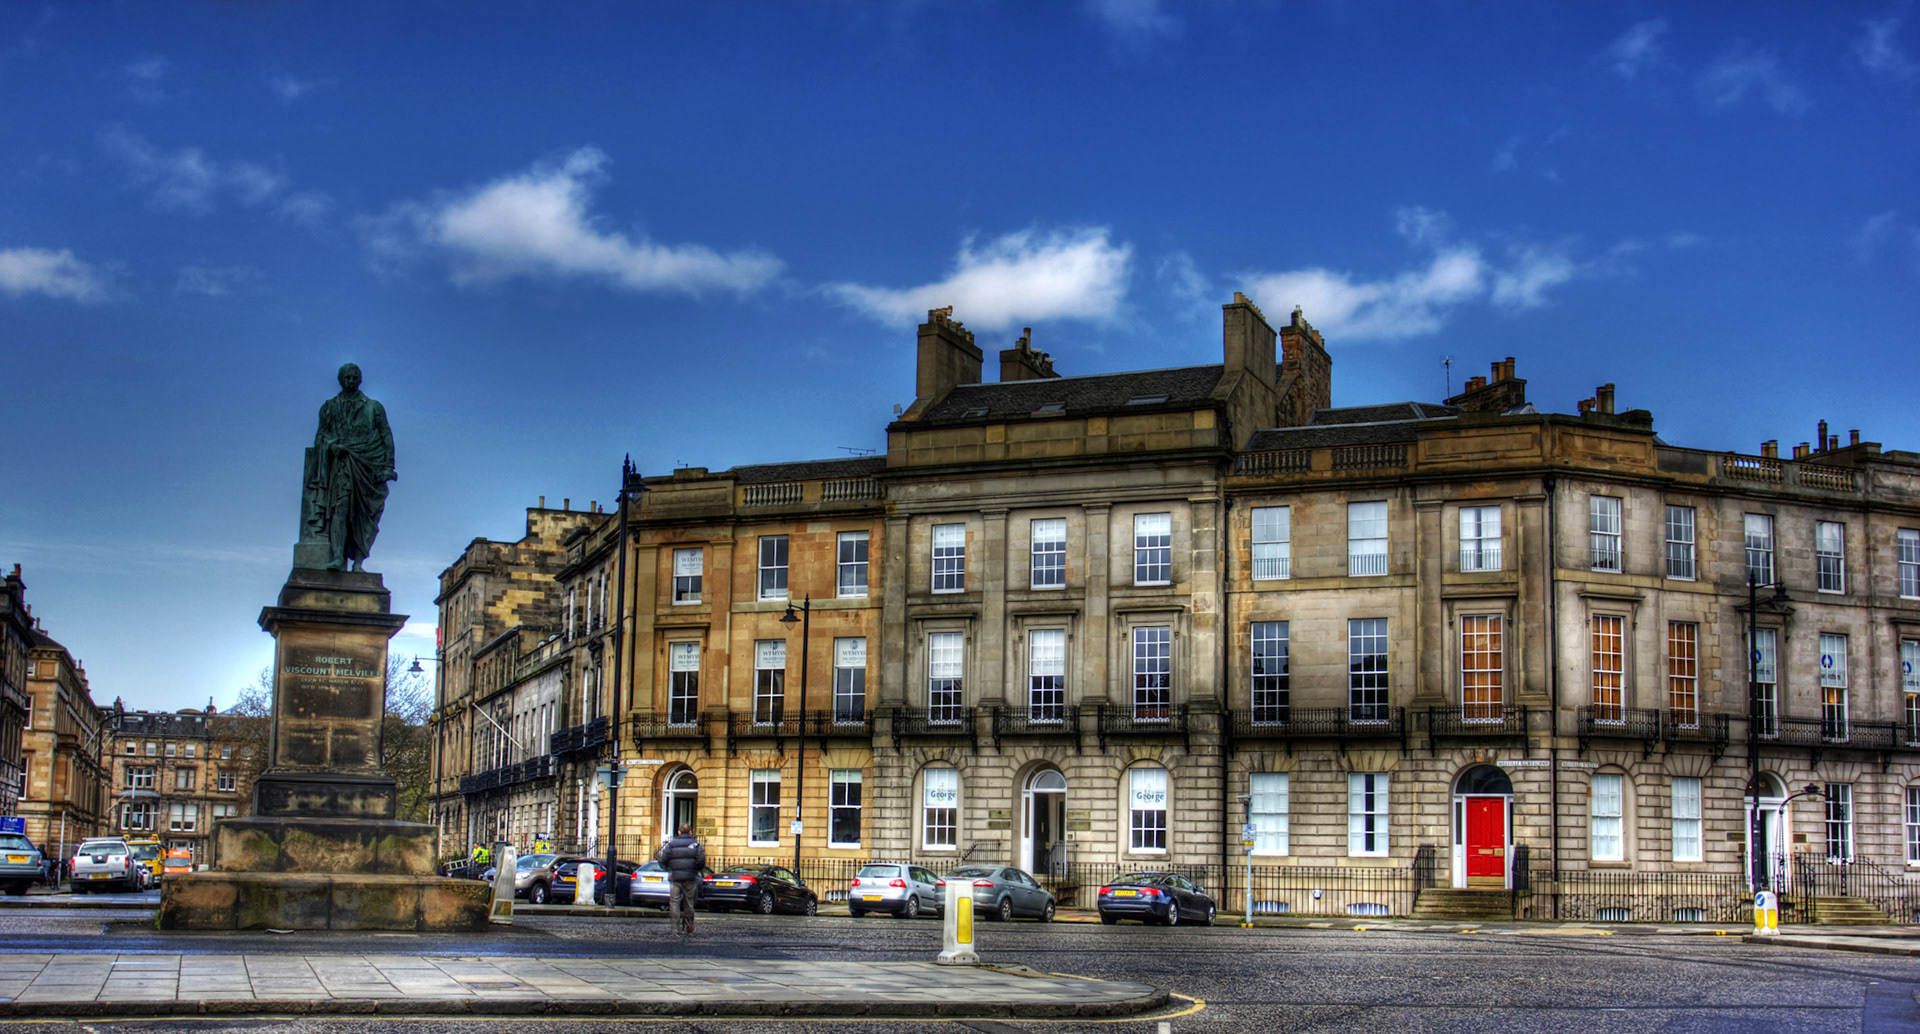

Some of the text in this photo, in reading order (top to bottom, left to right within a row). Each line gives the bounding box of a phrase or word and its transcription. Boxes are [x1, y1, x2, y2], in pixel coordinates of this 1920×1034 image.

[315, 656, 353, 665] ROBERT
[285, 666, 381, 677] VISCOUNT MELVILLE
[931, 790, 956, 801] George
[1136, 792, 1165, 803] George
